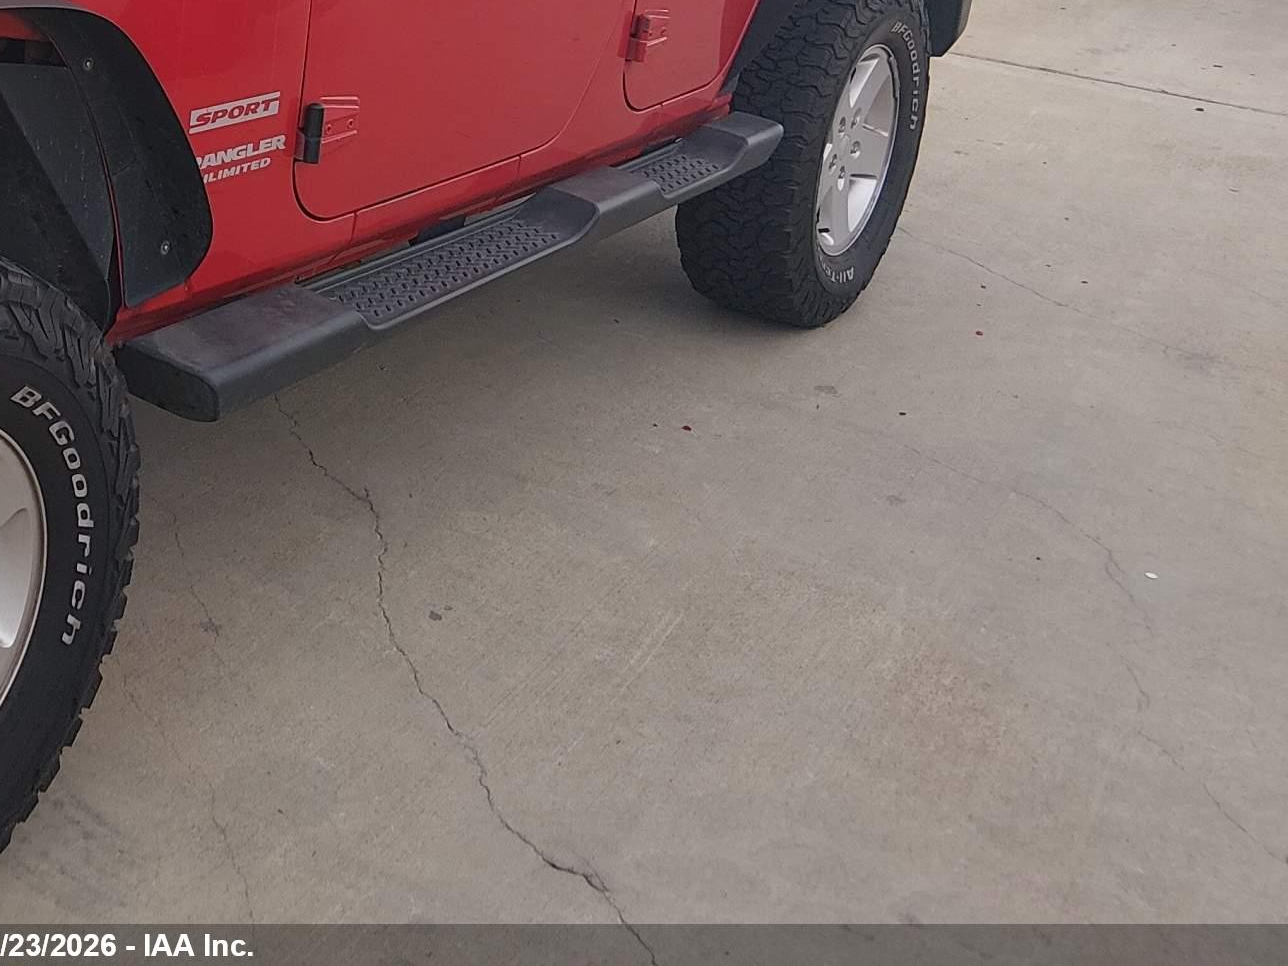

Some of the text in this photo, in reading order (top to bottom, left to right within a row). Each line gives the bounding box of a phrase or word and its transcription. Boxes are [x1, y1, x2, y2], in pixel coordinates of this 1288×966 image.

[891, 21, 921, 130] BFGoodrich
[191, 96, 279, 127] SPORT
[196, 135, 287, 170] ANGLER
[203, 157, 271, 184] LIMITED
[10, 385, 95, 645] BFGoodrich
